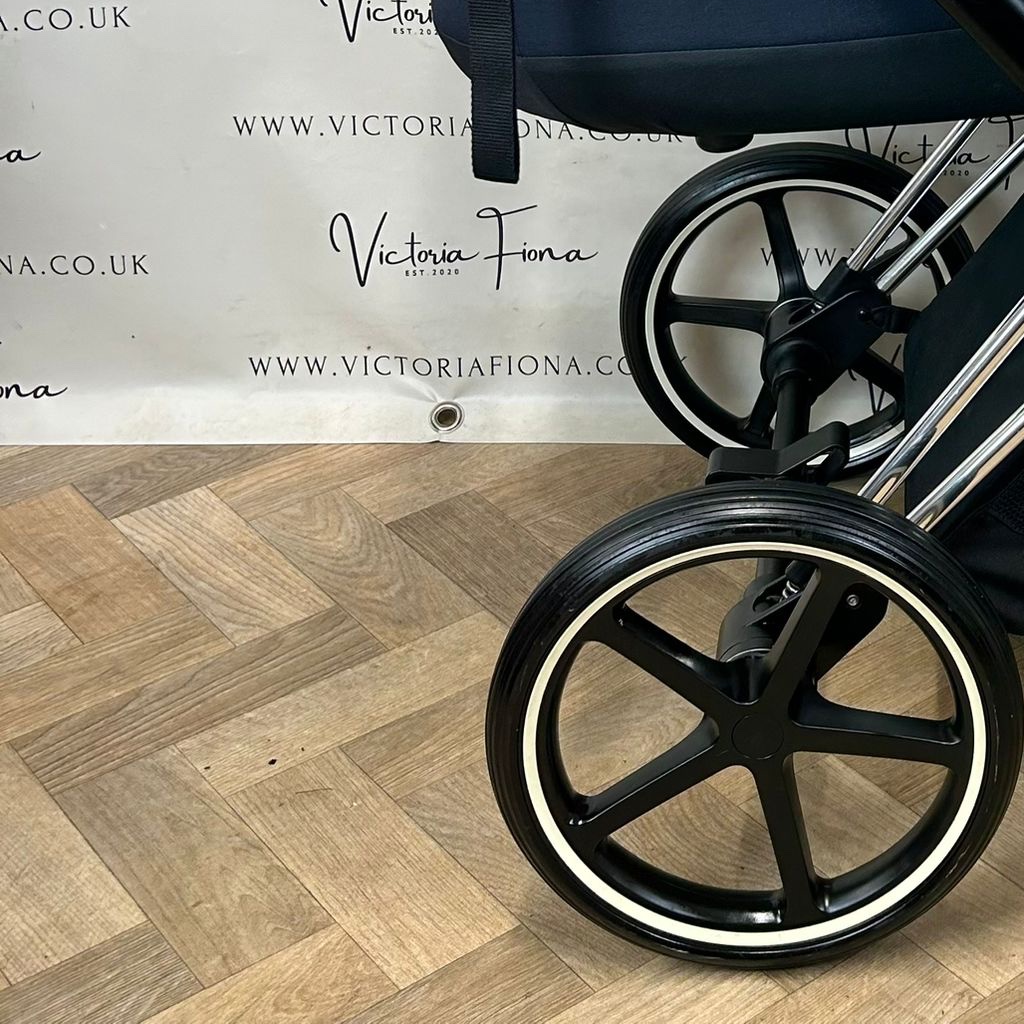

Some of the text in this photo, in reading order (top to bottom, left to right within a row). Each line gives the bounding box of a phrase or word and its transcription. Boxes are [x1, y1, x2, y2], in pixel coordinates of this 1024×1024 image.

[392, 27, 439, 36] EST.202
[329, 205, 599, 290] Victoria Fiona
[404, 268, 460, 277] EST.2020
